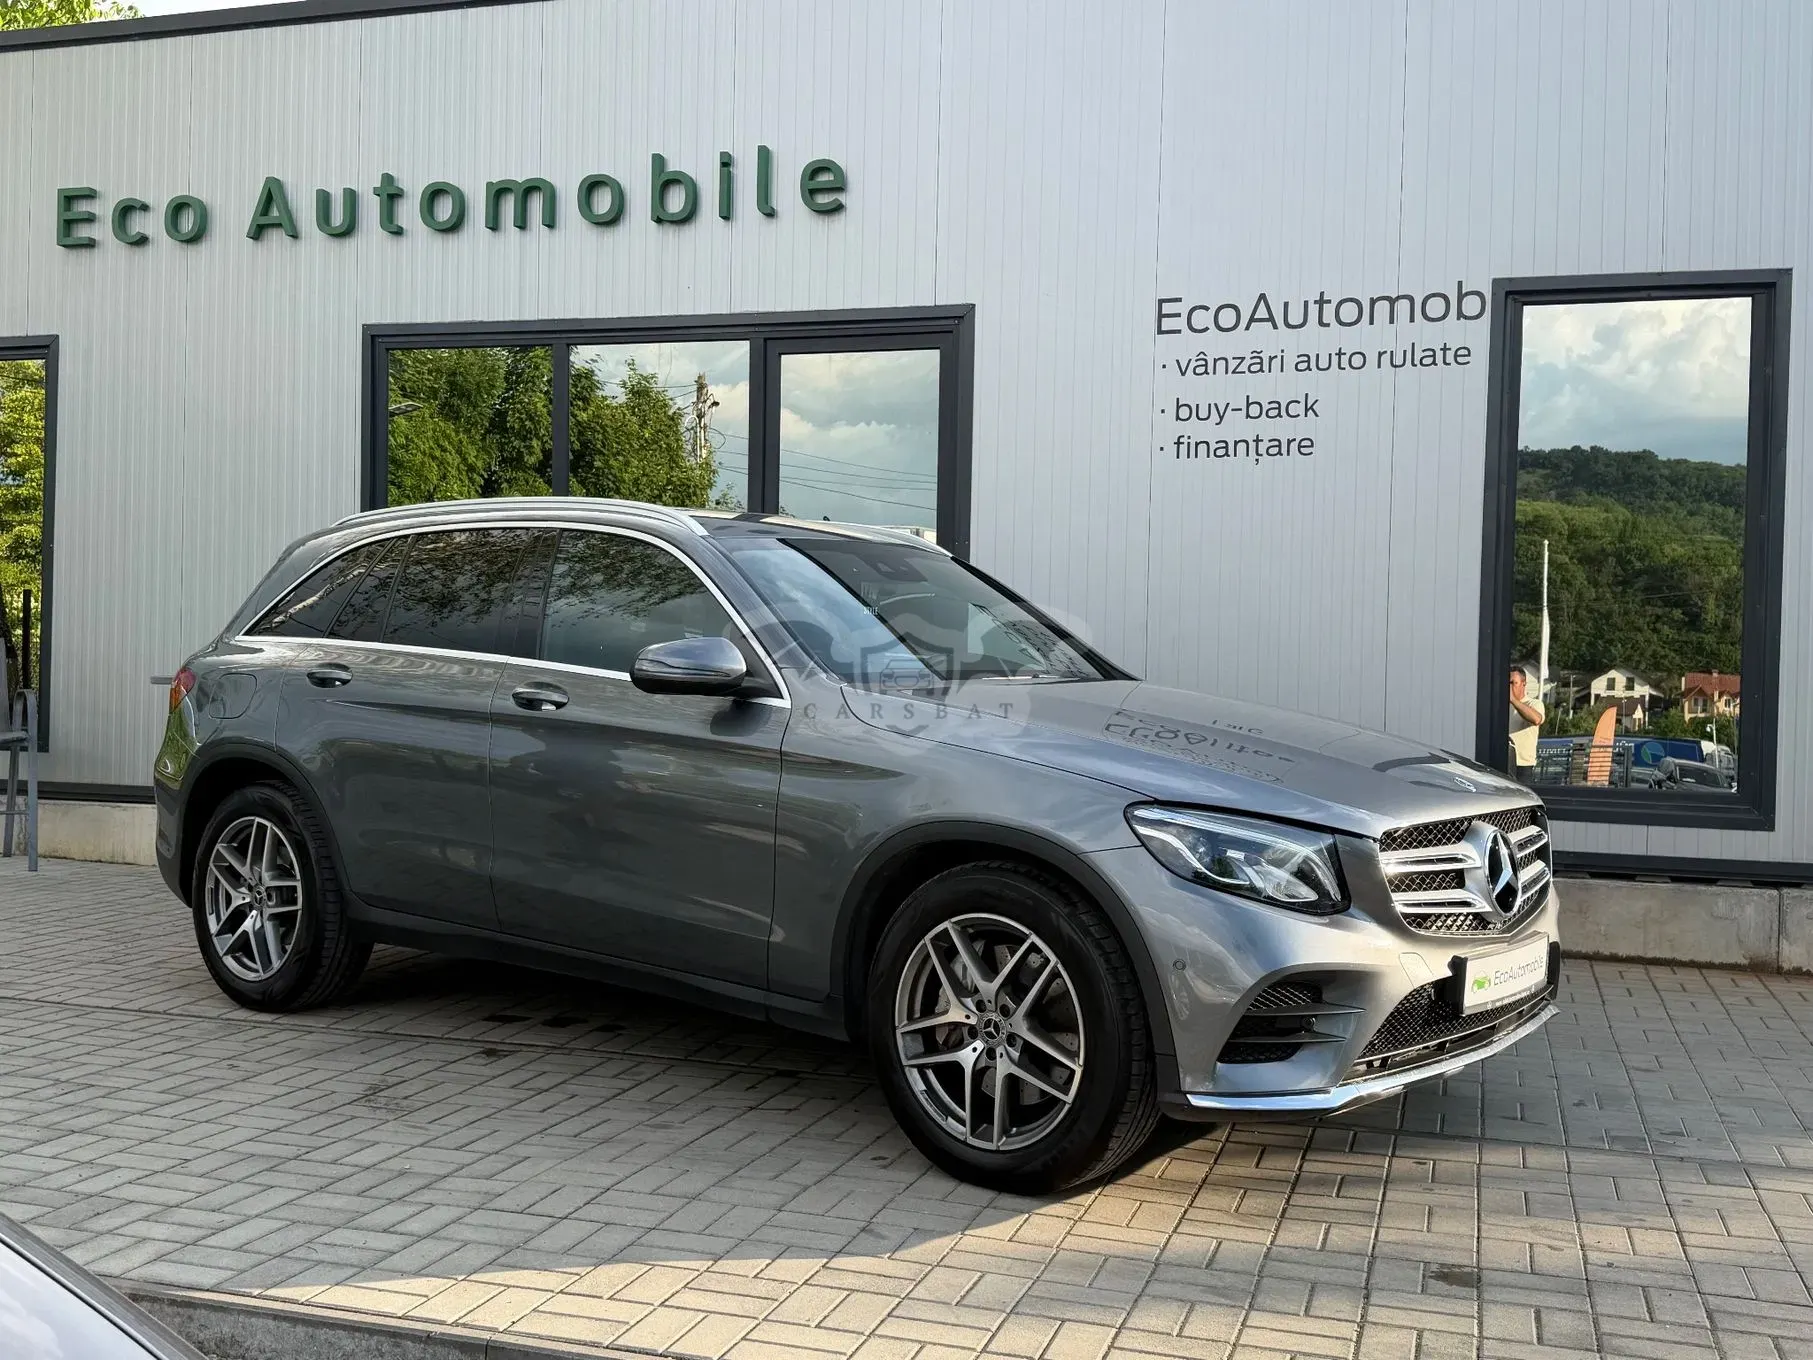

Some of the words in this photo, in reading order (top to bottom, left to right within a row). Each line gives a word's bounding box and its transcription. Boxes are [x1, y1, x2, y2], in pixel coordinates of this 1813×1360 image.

[57, 188, 208, 247] Eco
[247, 145, 847, 239] Automobile
[1155, 280, 1487, 335] EcoAutomob
[1294, 347, 1367, 373] auto
[1377, 342, 1472, 369] rulate
[1175, 393, 1320, 425] buy-back
